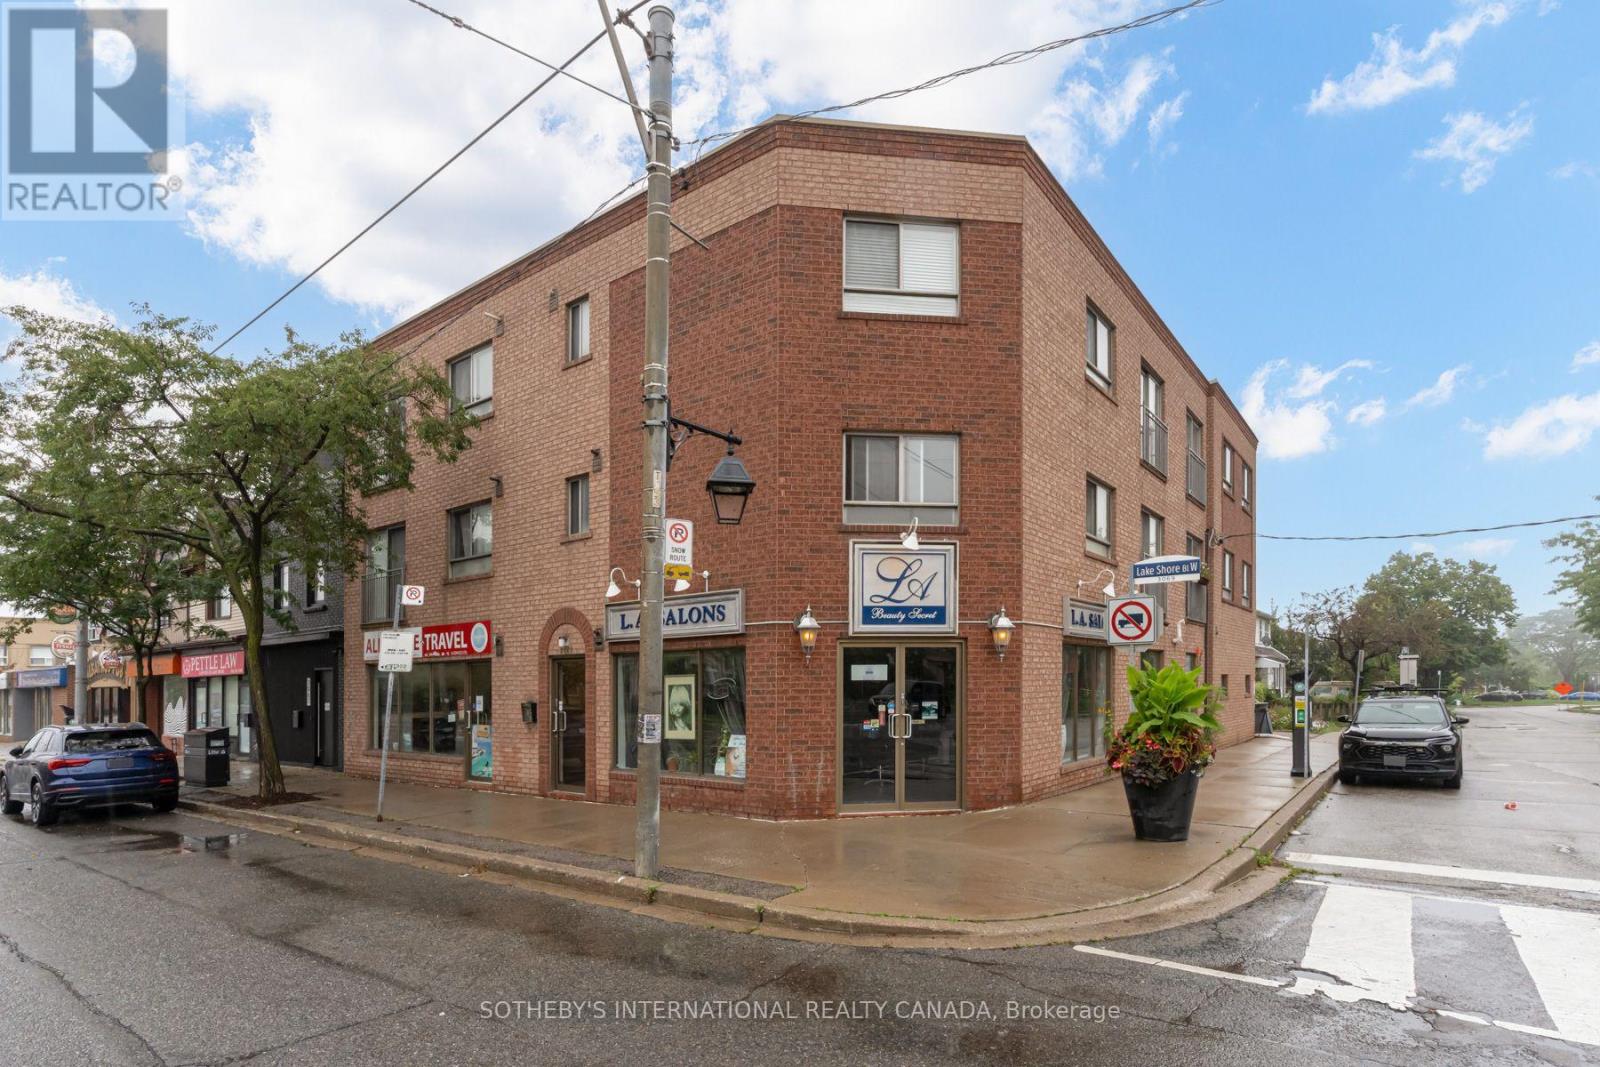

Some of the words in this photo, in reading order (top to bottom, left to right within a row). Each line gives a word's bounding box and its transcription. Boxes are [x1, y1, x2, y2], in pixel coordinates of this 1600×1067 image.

[1136, 566, 1155, 577] Lake
[1156, 564, 1181, 575] Shore
[1190, 561, 1198, 572] W
[871, 607, 906, 623] Beauty
[908, 607, 938, 619] Secret
[424, 631, 468, 651] TRAVEL
[190, 655, 219, 672] PETTLE
[220, 652, 237, 669] LAW
